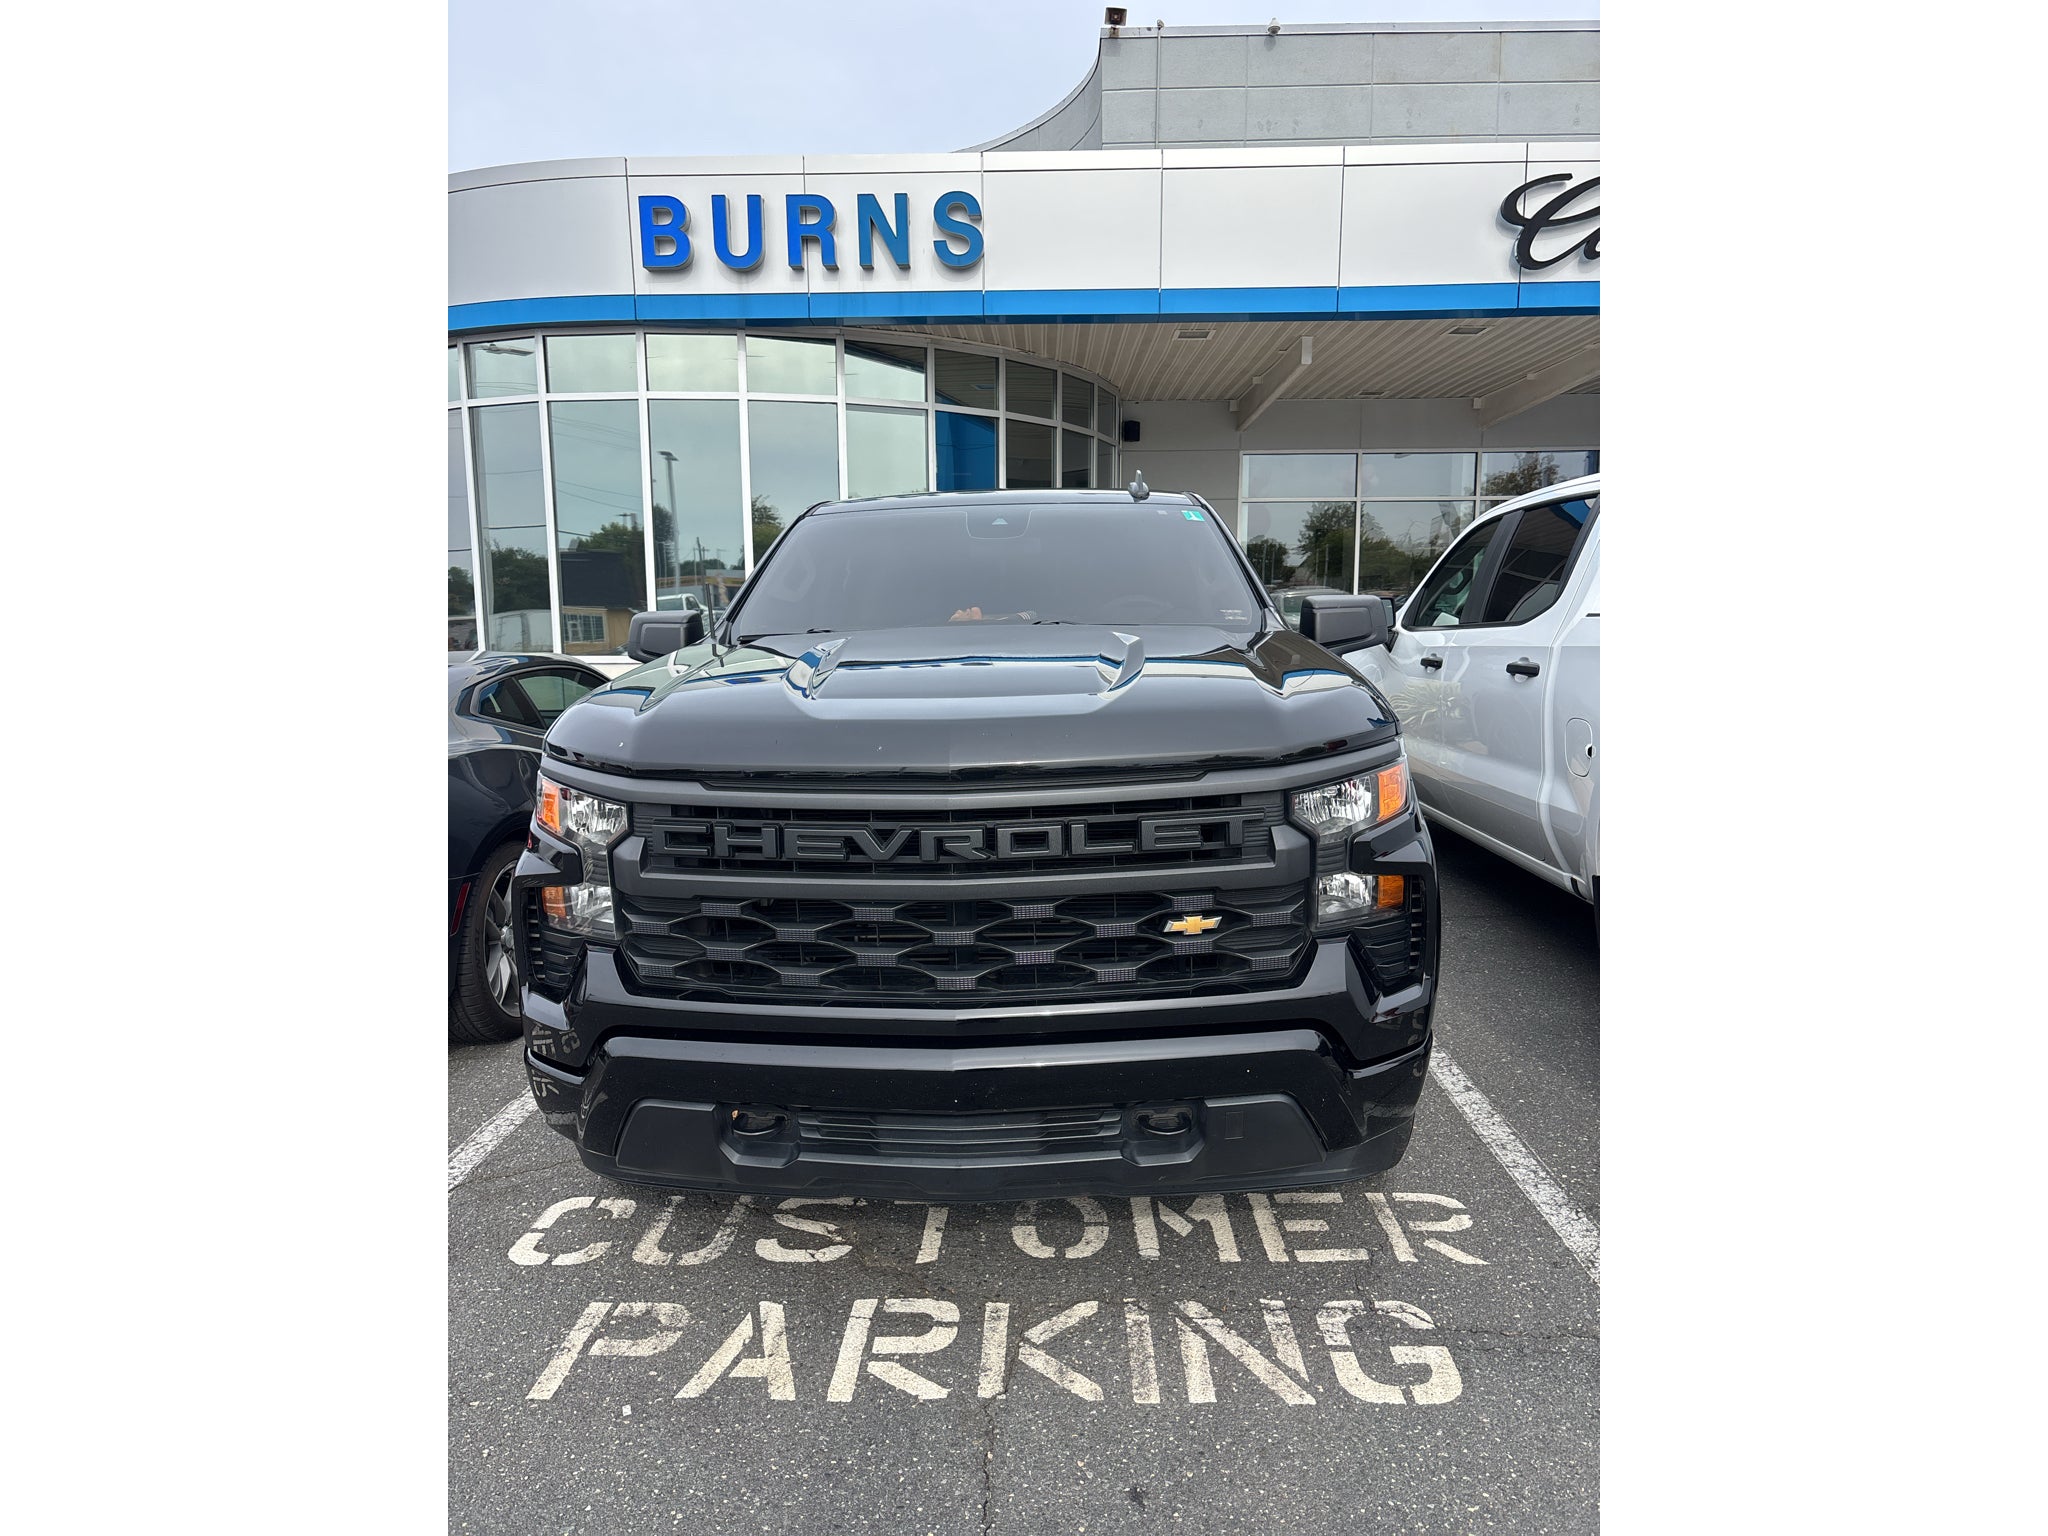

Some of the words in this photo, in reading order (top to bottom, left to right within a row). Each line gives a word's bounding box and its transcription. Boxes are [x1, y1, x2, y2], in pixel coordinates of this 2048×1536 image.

[638, 190, 985, 273] BURNS
[651, 812, 1266, 862] CHEVROLET
[507, 1191, 1490, 1267] CUSTOMER
[526, 1297, 1464, 1406] PARKING
